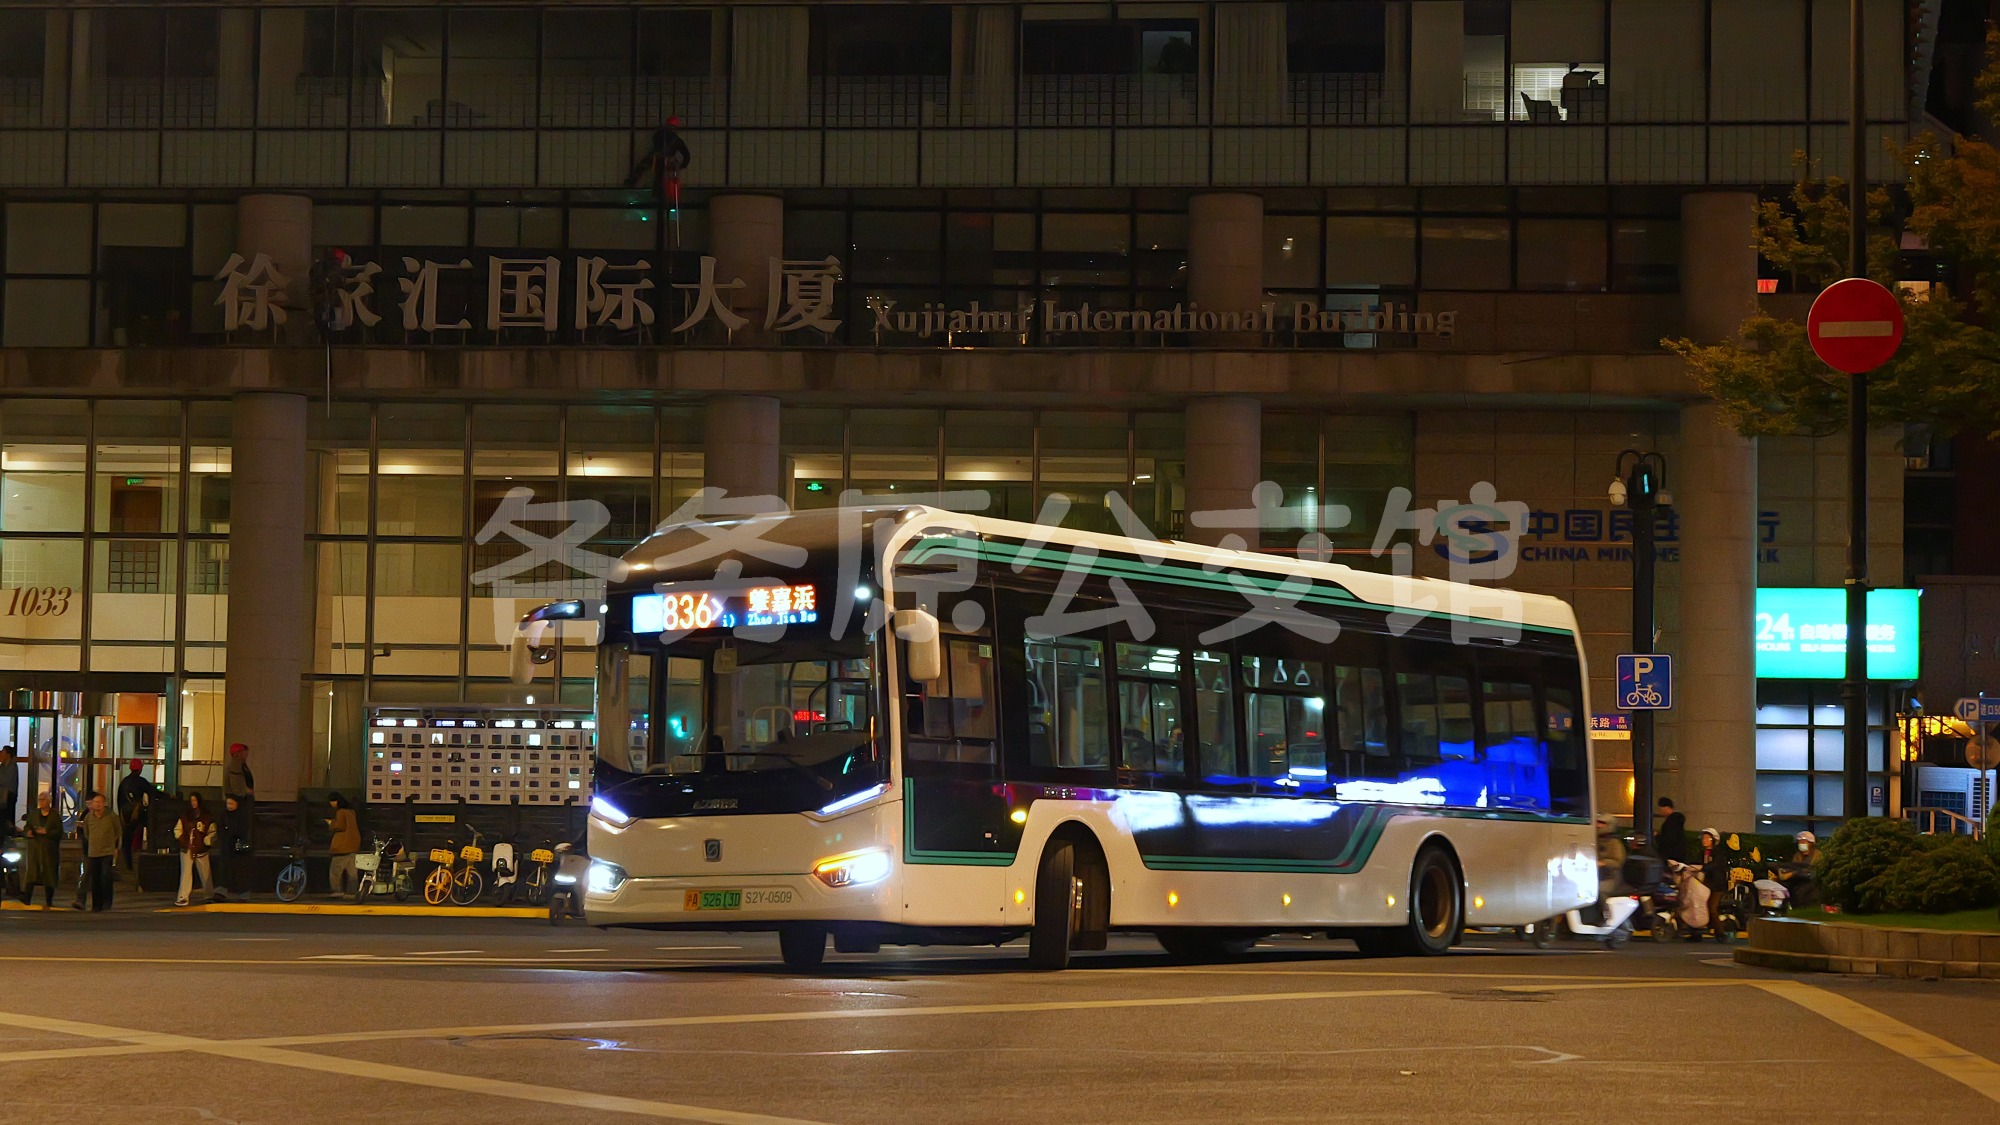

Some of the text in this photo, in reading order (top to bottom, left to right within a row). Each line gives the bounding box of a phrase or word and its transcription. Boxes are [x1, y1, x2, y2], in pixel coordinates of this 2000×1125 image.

[868, 300, 1459, 339] Xujiahui International Building
[1521, 547, 1588, 562] CHINA
[4, 586, 72, 617] 1033
[663, 593, 712, 630] 836
[748, 586, 816, 613] 肇嘉浜
[748, 614, 772, 626] Zhao
[776, 612, 797, 625] Jia
[1634, 658, 1653, 682] P
[1966, 702, 1977, 717] P
[745, 891, 792, 904] S2Y-0509
